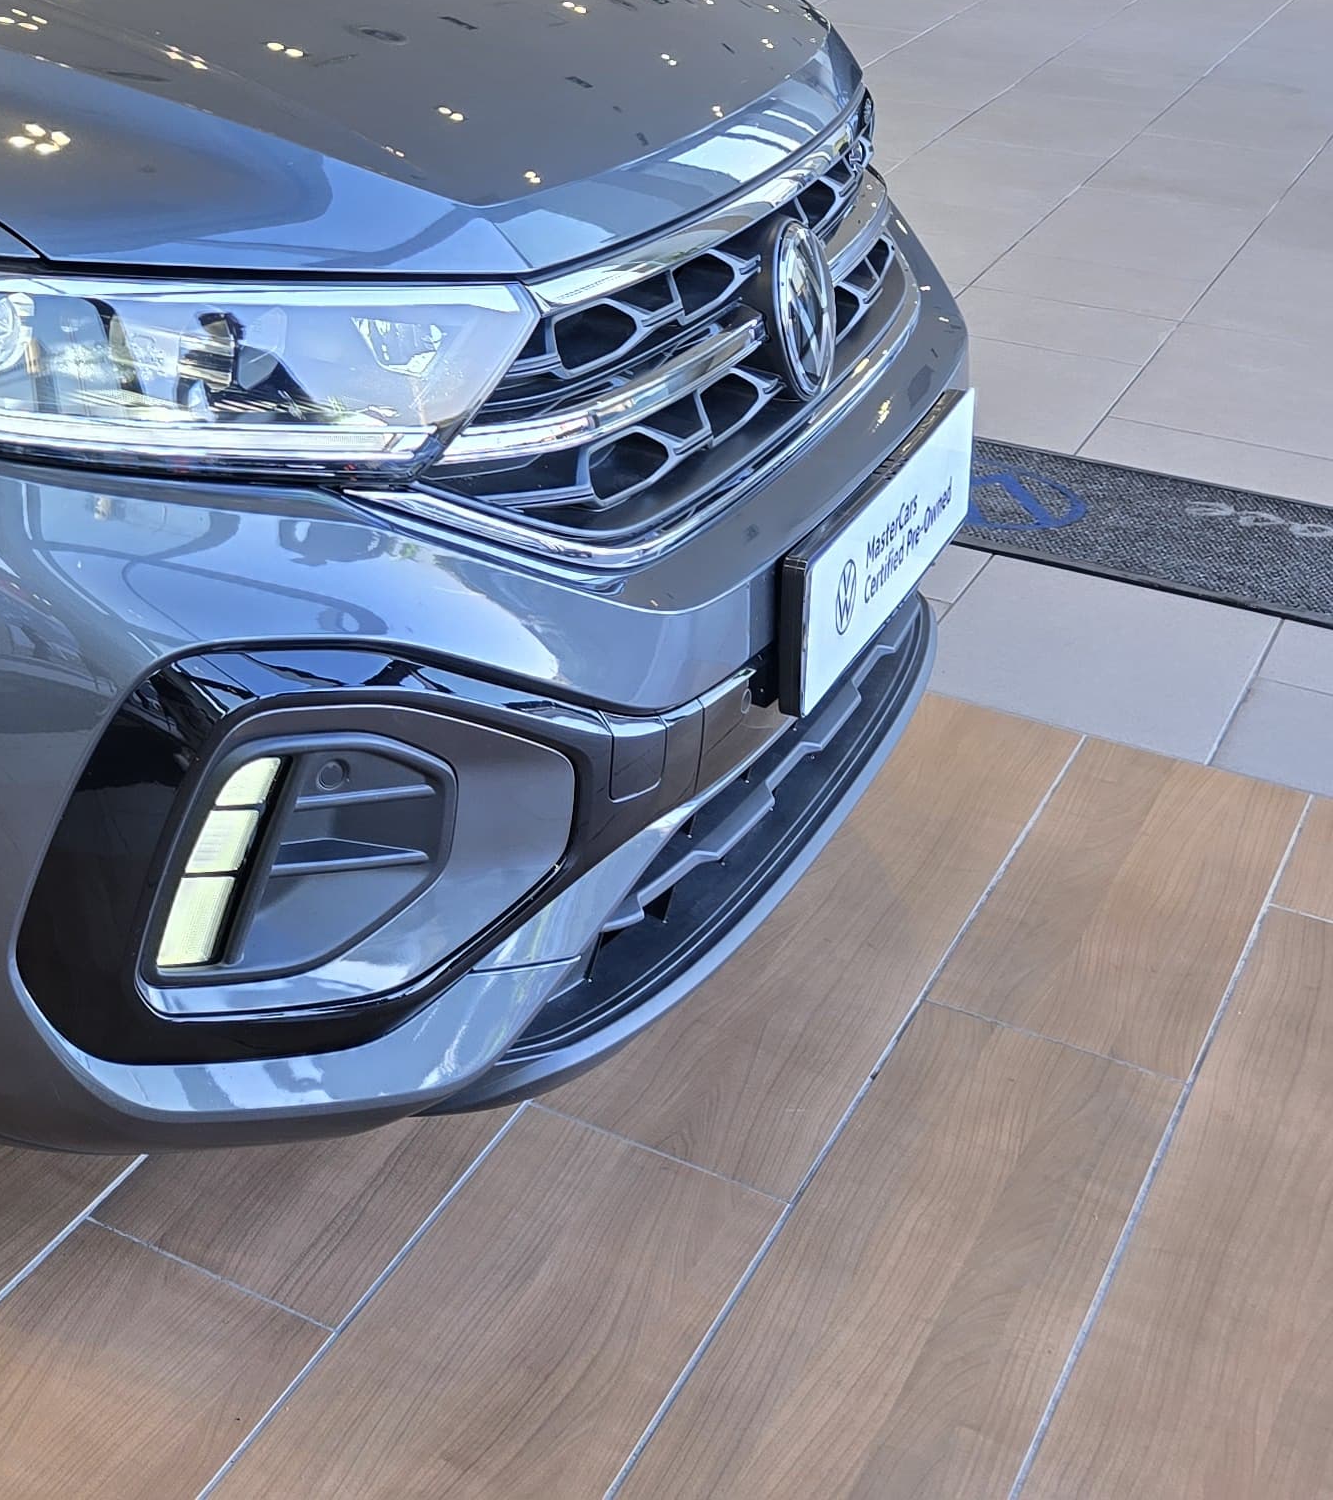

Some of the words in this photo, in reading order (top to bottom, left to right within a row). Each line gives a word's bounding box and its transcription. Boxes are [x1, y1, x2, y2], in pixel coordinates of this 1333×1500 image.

[864, 535, 906, 604] Certified
[906, 476, 953, 556] Pre-Owned
[865, 494, 919, 570] MasterCars
